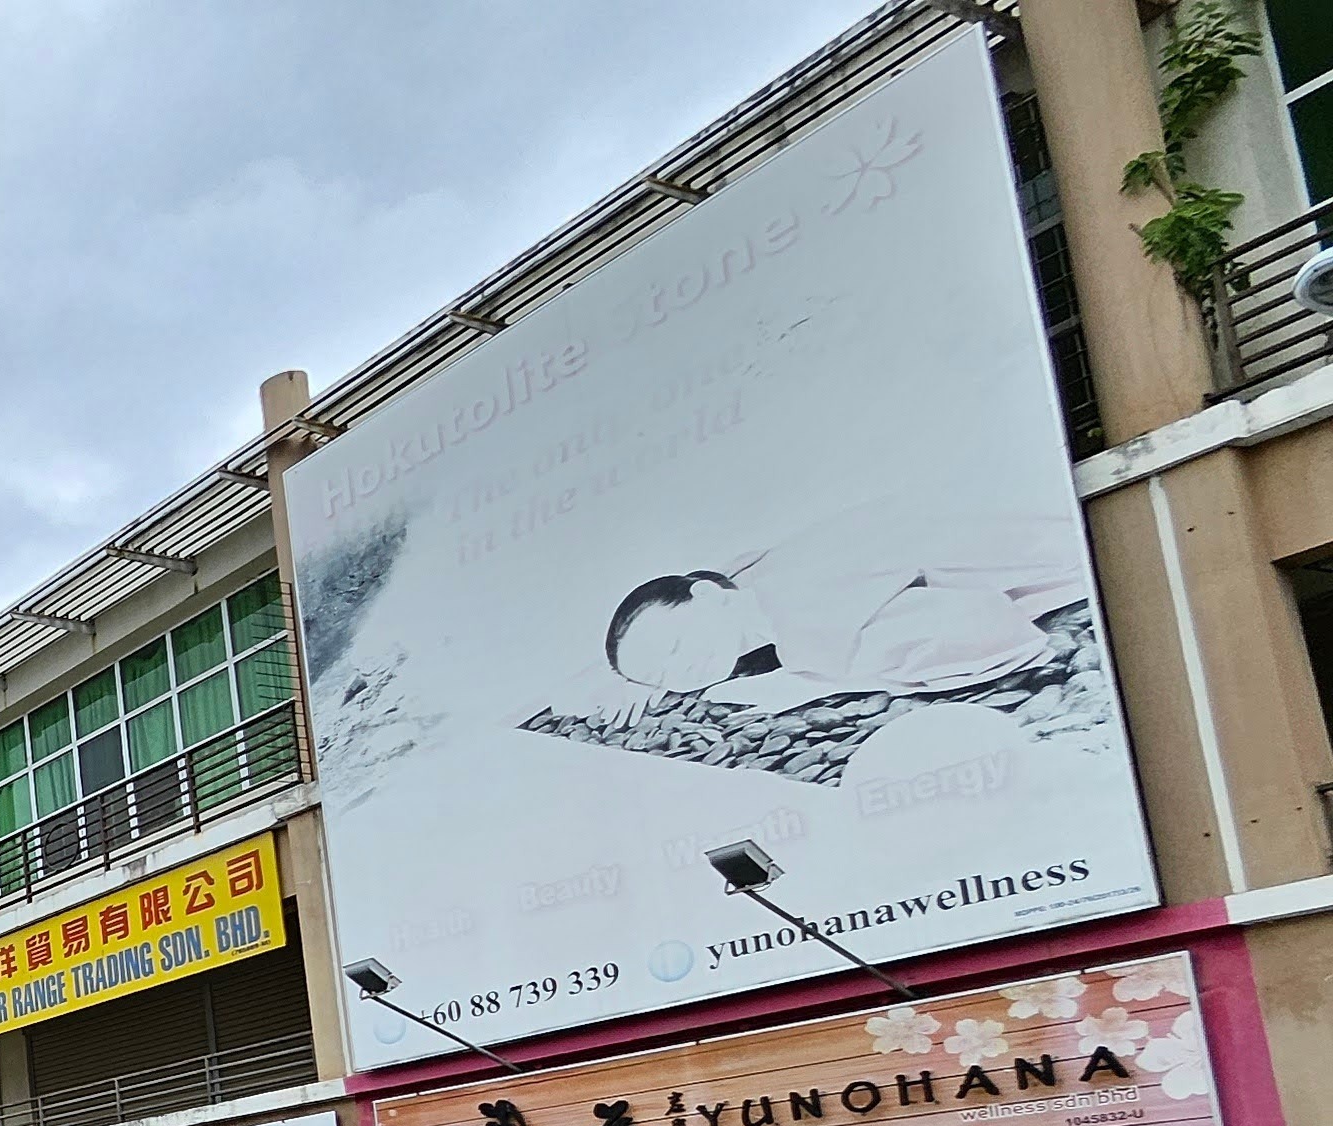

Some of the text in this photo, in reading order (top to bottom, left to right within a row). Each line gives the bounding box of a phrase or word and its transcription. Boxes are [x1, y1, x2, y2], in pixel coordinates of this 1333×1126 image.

[856, 748, 1017, 817] Energy
[662, 804, 810, 872] Wmth
[517, 861, 624, 914] Beauty
[705, 856, 1091, 970] yunohanawellness
[11, 970, 69, 1020] RANGE
[71, 940, 156, 999] TRADING
[156, 924, 211, 973] SDN.
[213, 904, 271, 955] BHD.
[469, 990, 502, 1018] 88
[508, 976, 559, 1009] 739
[566, 961, 621, 996] 339
[960, 1086, 1139, 1122] wellness sdn bhd
